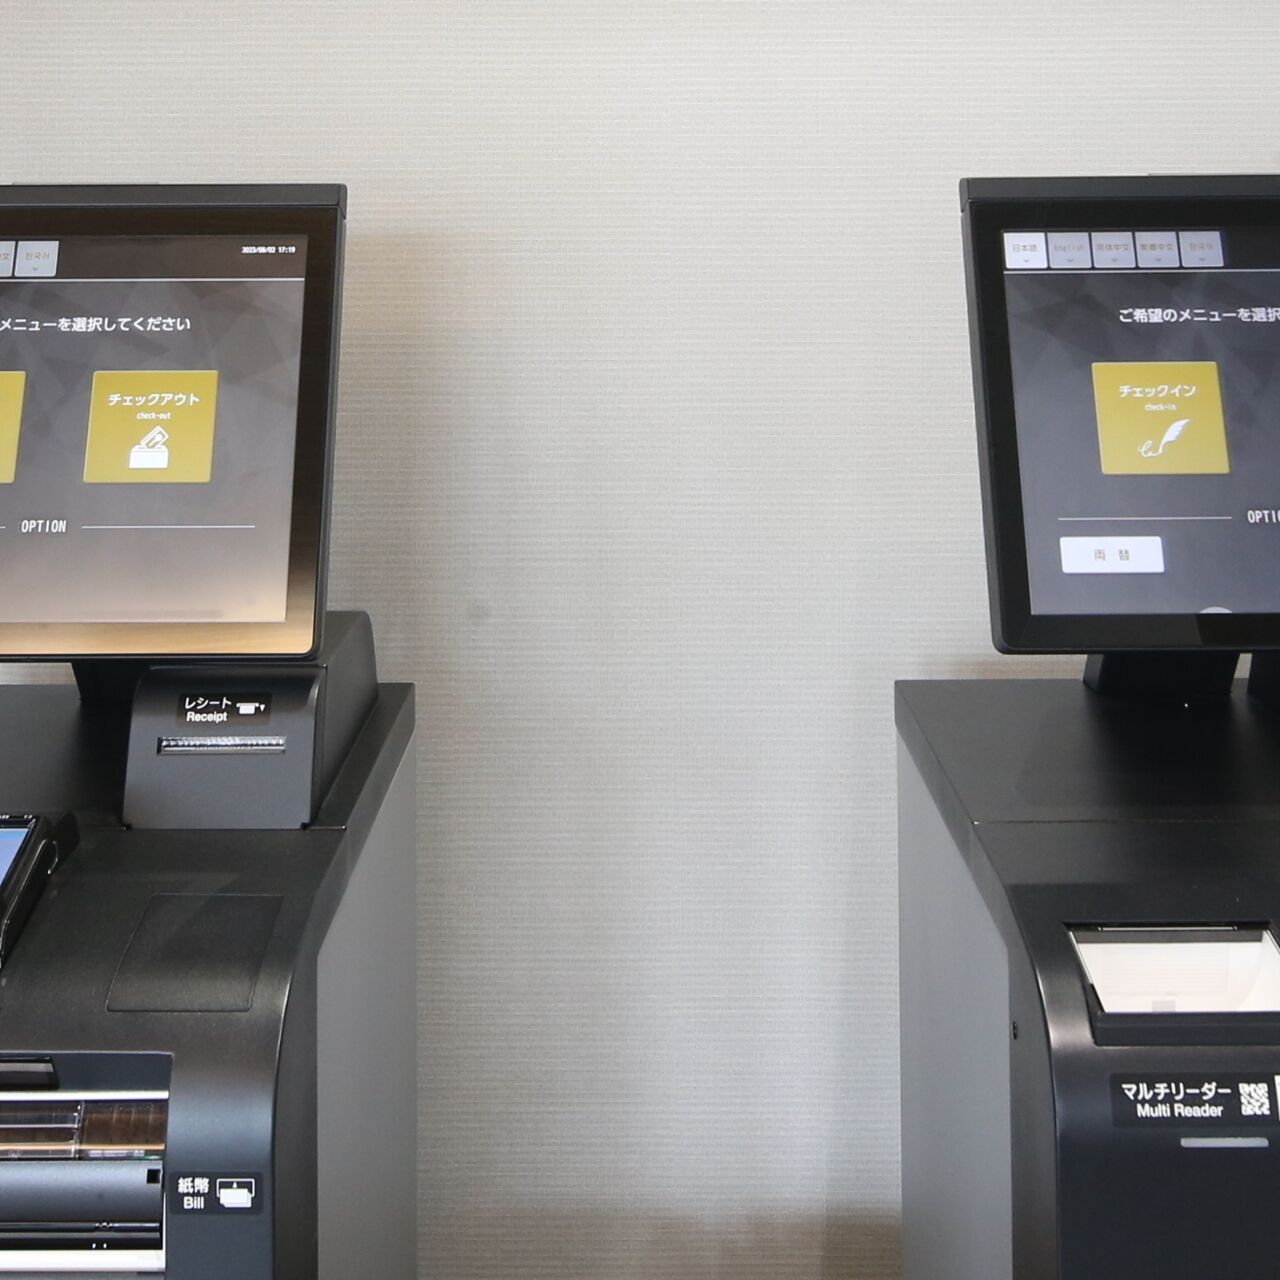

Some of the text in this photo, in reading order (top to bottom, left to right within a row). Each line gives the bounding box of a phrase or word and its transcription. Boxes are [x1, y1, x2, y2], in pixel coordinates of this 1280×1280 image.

[25, 252, 50, 261] 한국어
[1119, 384, 1197, 398] チェックイン
[108, 393, 200, 406] チェックアウト
[136, 411, 171, 420] check-out
[21, 519, 67, 533] OPTION
[184, 696, 232, 709] レシート
[186, 711, 228, 723] Receipt
[1121, 1082, 1232, 1101] マルチリーダー
[1137, 1103, 1224, 1117] Multi Reader
[177, 1177, 210, 1194] 紙幣
[183, 1197, 205, 1210] Bill
